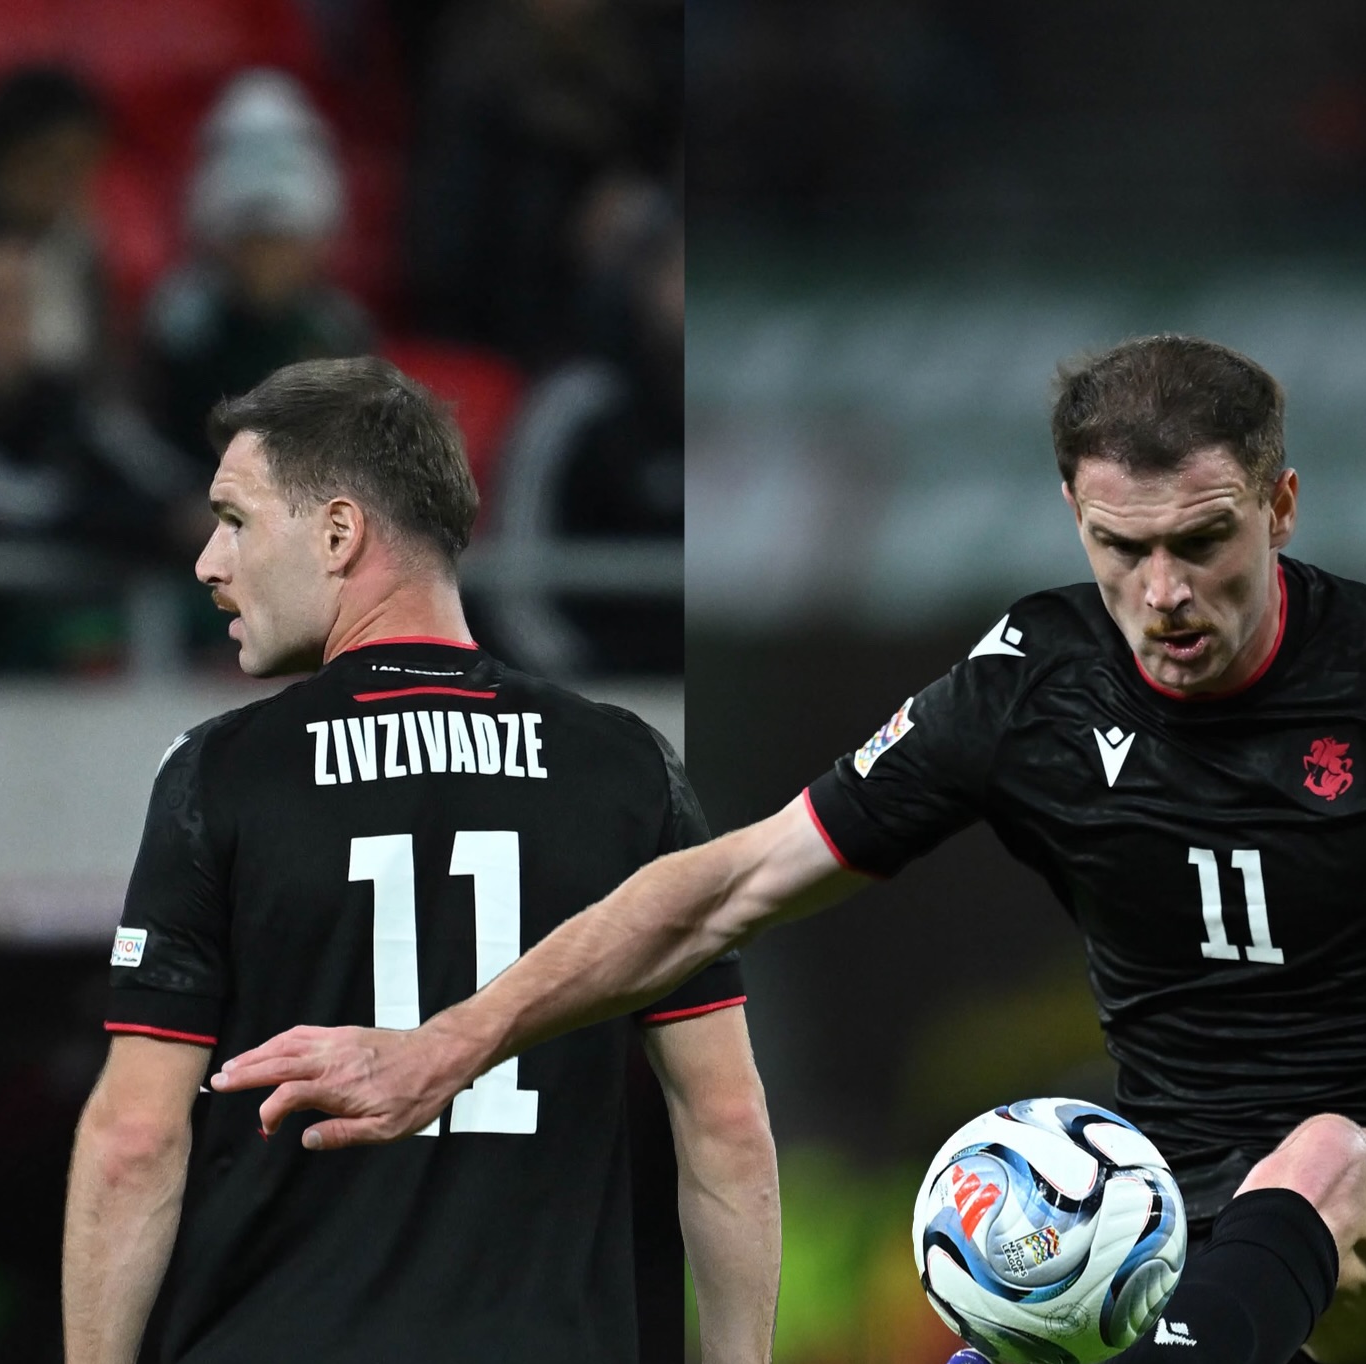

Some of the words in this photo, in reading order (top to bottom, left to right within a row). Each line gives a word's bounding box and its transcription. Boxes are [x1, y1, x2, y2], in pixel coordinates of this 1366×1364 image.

[306, 711, 547, 785] ZIVZIVADZE
[1188, 847, 1285, 965] 11
[348, 830, 539, 1137] 11
[1002, 1243, 1020, 1275] LEAGUE
[1008, 1241, 1027, 1277] NATIONS
